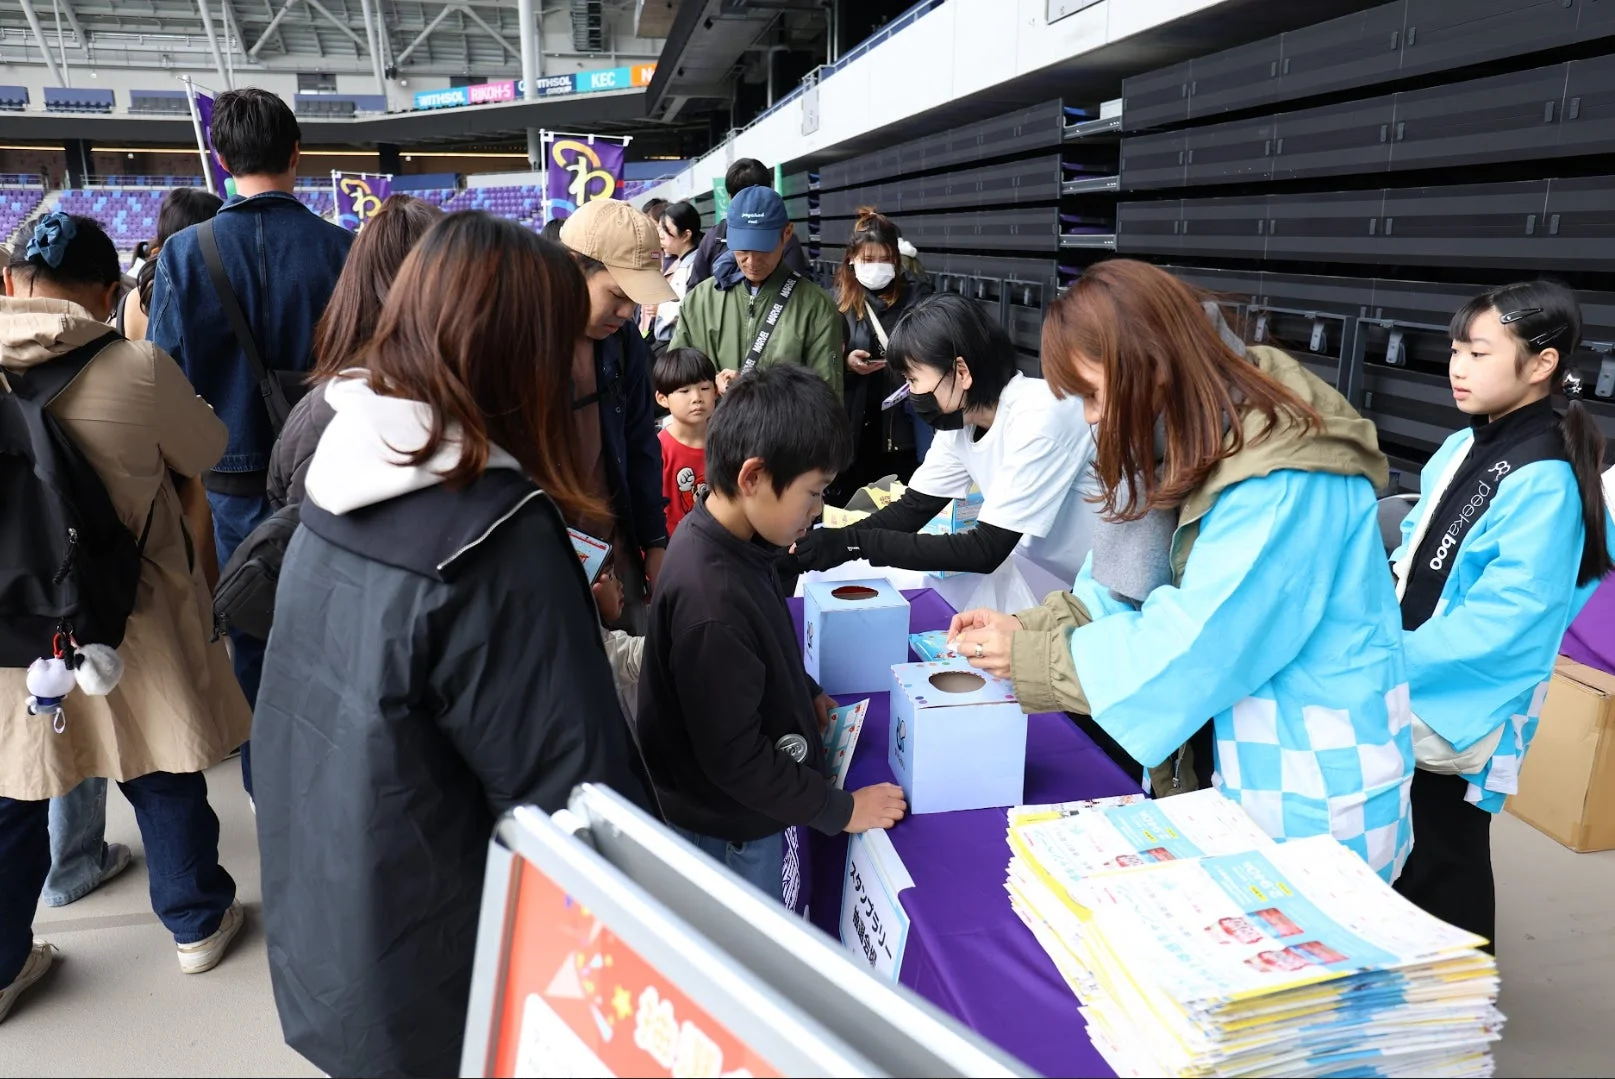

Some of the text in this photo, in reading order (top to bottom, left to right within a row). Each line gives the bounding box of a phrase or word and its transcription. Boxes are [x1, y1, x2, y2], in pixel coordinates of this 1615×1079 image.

[591, 72, 616, 88] KEC
[418, 91, 466, 107] WITHSOL
[780, 278, 797, 298] MARVEL
[766, 303, 784, 326] MARVEL
[752, 330, 770, 354] MARVEL
[1429, 479, 1492, 571] peekaboo
[848, 859, 893, 960] スタンプラリー
